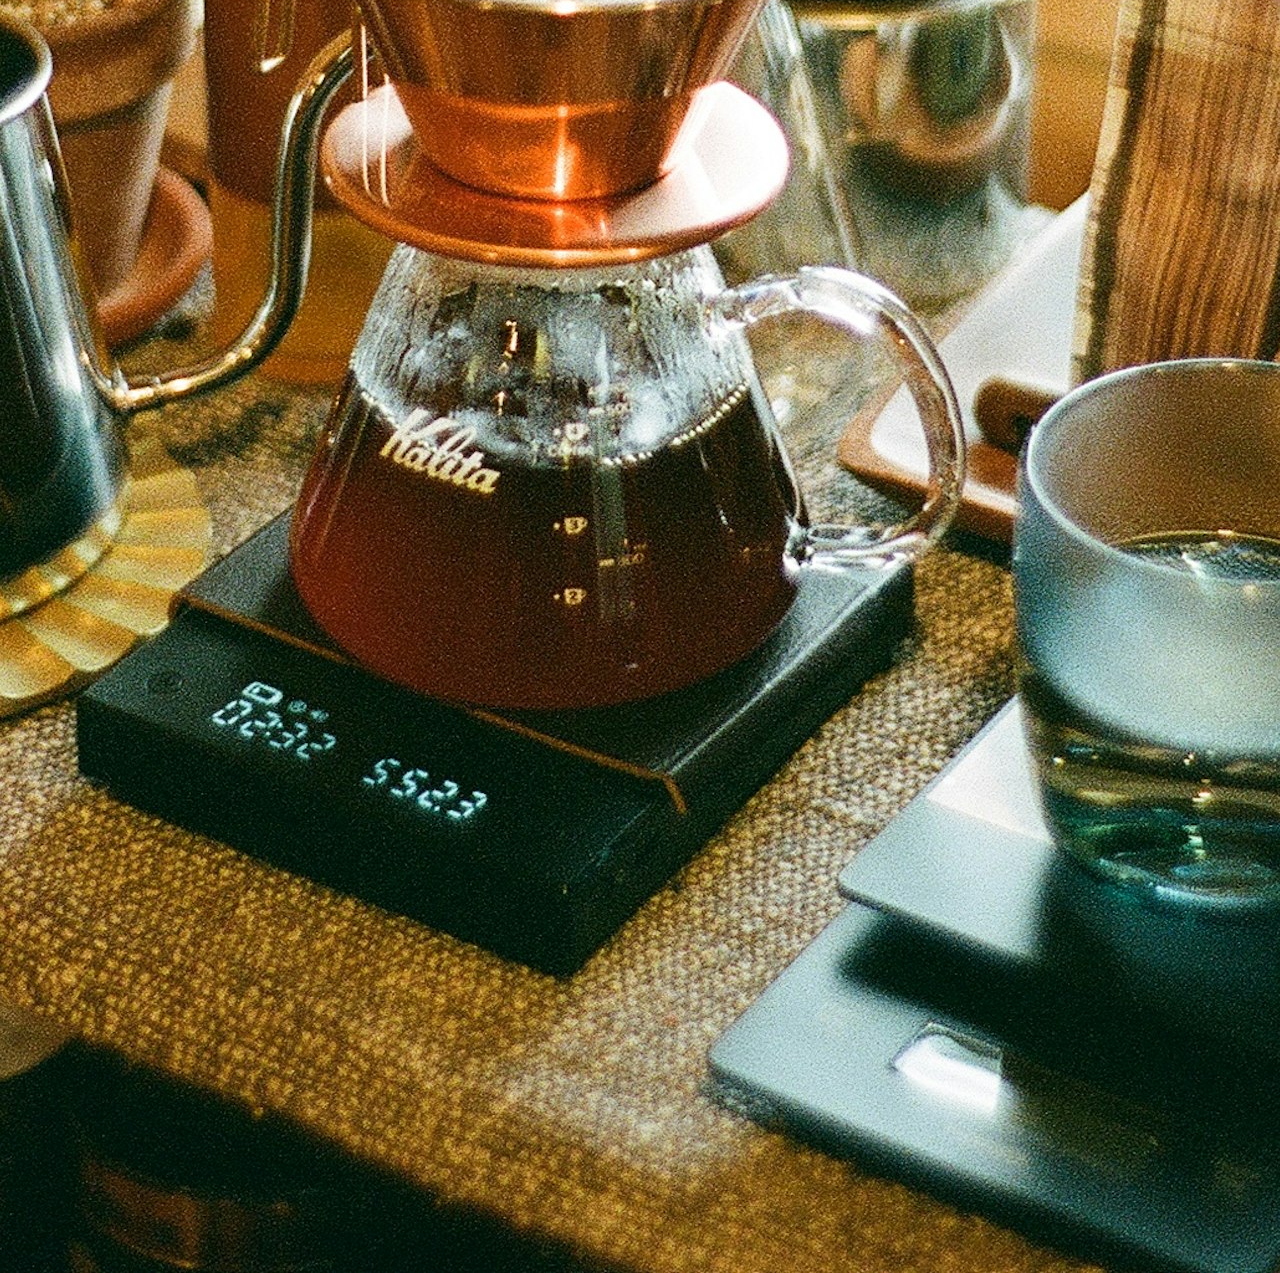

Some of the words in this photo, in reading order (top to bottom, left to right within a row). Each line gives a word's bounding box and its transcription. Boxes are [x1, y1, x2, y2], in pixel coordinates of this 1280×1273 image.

[380, 407, 501, 495] Kalita
[211, 698, 337, 761] 02:32
[362, 757, 488, 821] 552.3
